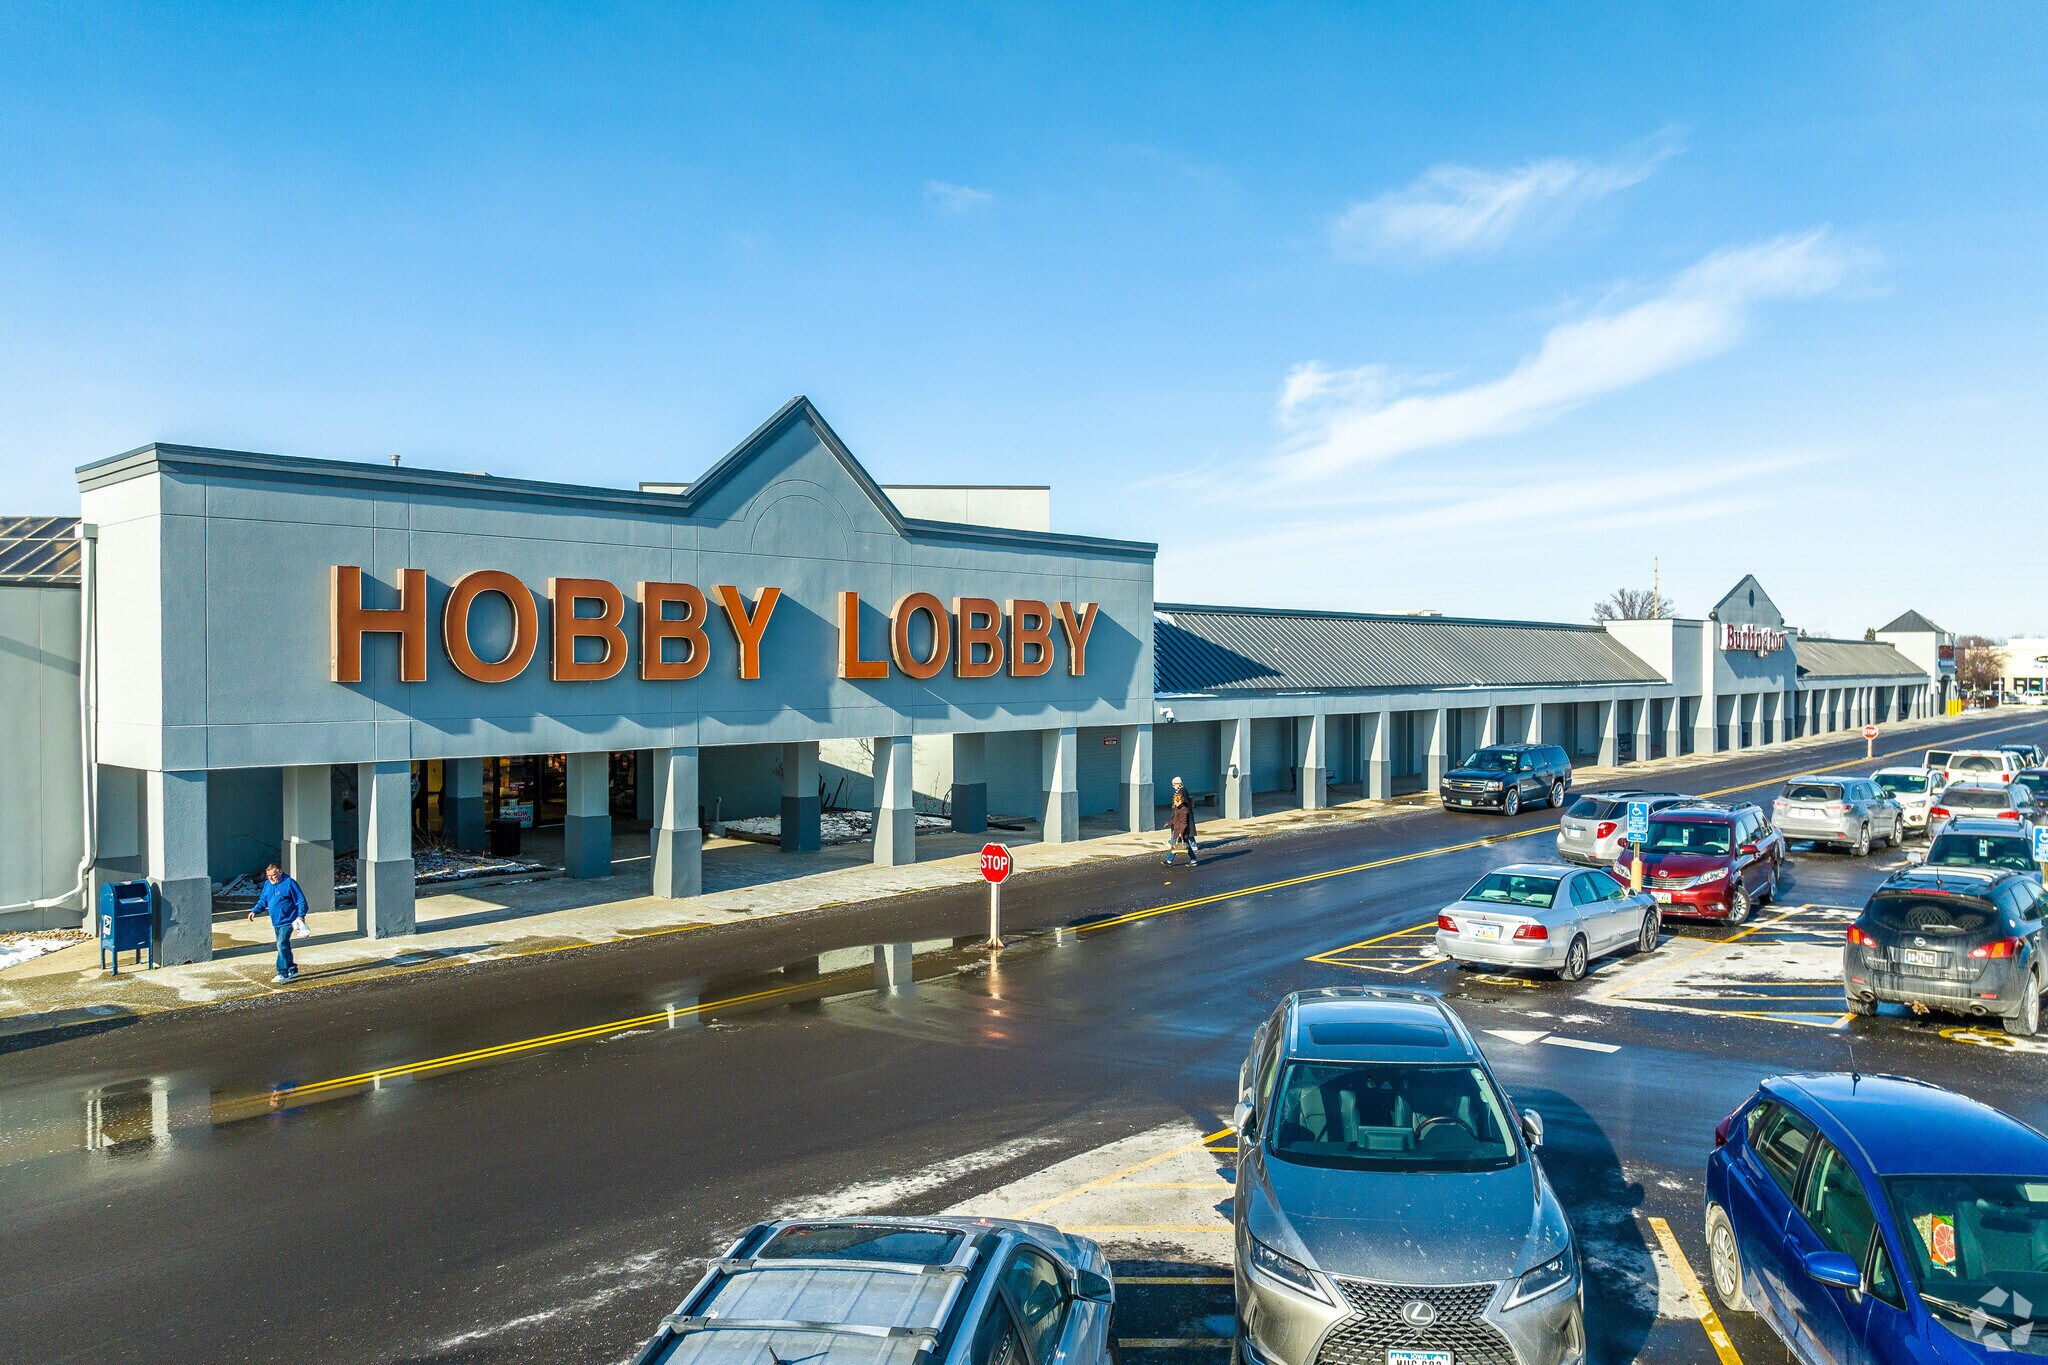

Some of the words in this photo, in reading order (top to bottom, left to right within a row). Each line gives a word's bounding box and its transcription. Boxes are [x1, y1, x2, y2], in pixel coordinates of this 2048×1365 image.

[331, 565, 783, 683] HOBBY
[838, 592, 1100, 679] LOBBY
[1721, 624, 1788, 657] Burlington
[981, 854, 1008, 871] STOP
[1411, 1353, 1428, 1361] IOWA
